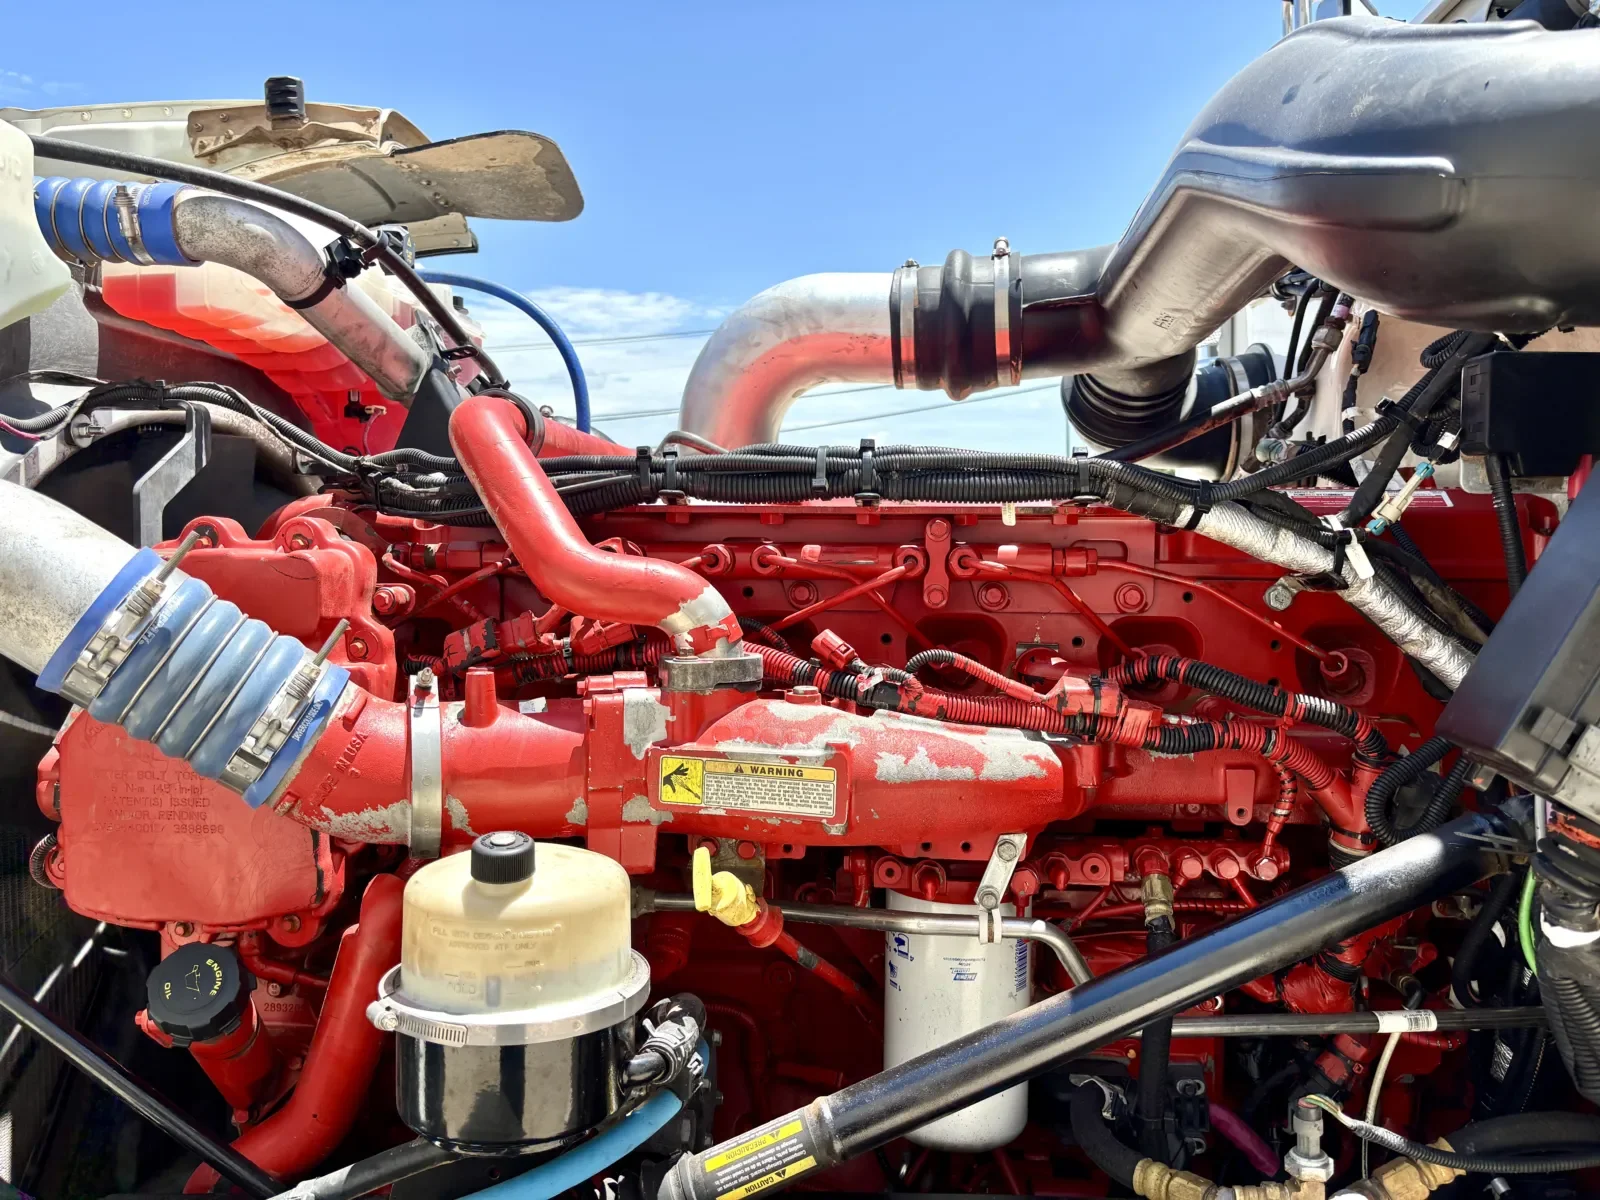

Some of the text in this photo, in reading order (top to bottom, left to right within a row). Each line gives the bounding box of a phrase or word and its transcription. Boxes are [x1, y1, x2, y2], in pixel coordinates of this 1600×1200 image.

[344, 731, 368, 758] USA
[750, 766, 804, 778] WARNING
[170, 797, 210, 807] ISSUED
[164, 958, 222, 1000] ENGINE OIL
[745, 1176, 774, 1194] CAUTION
